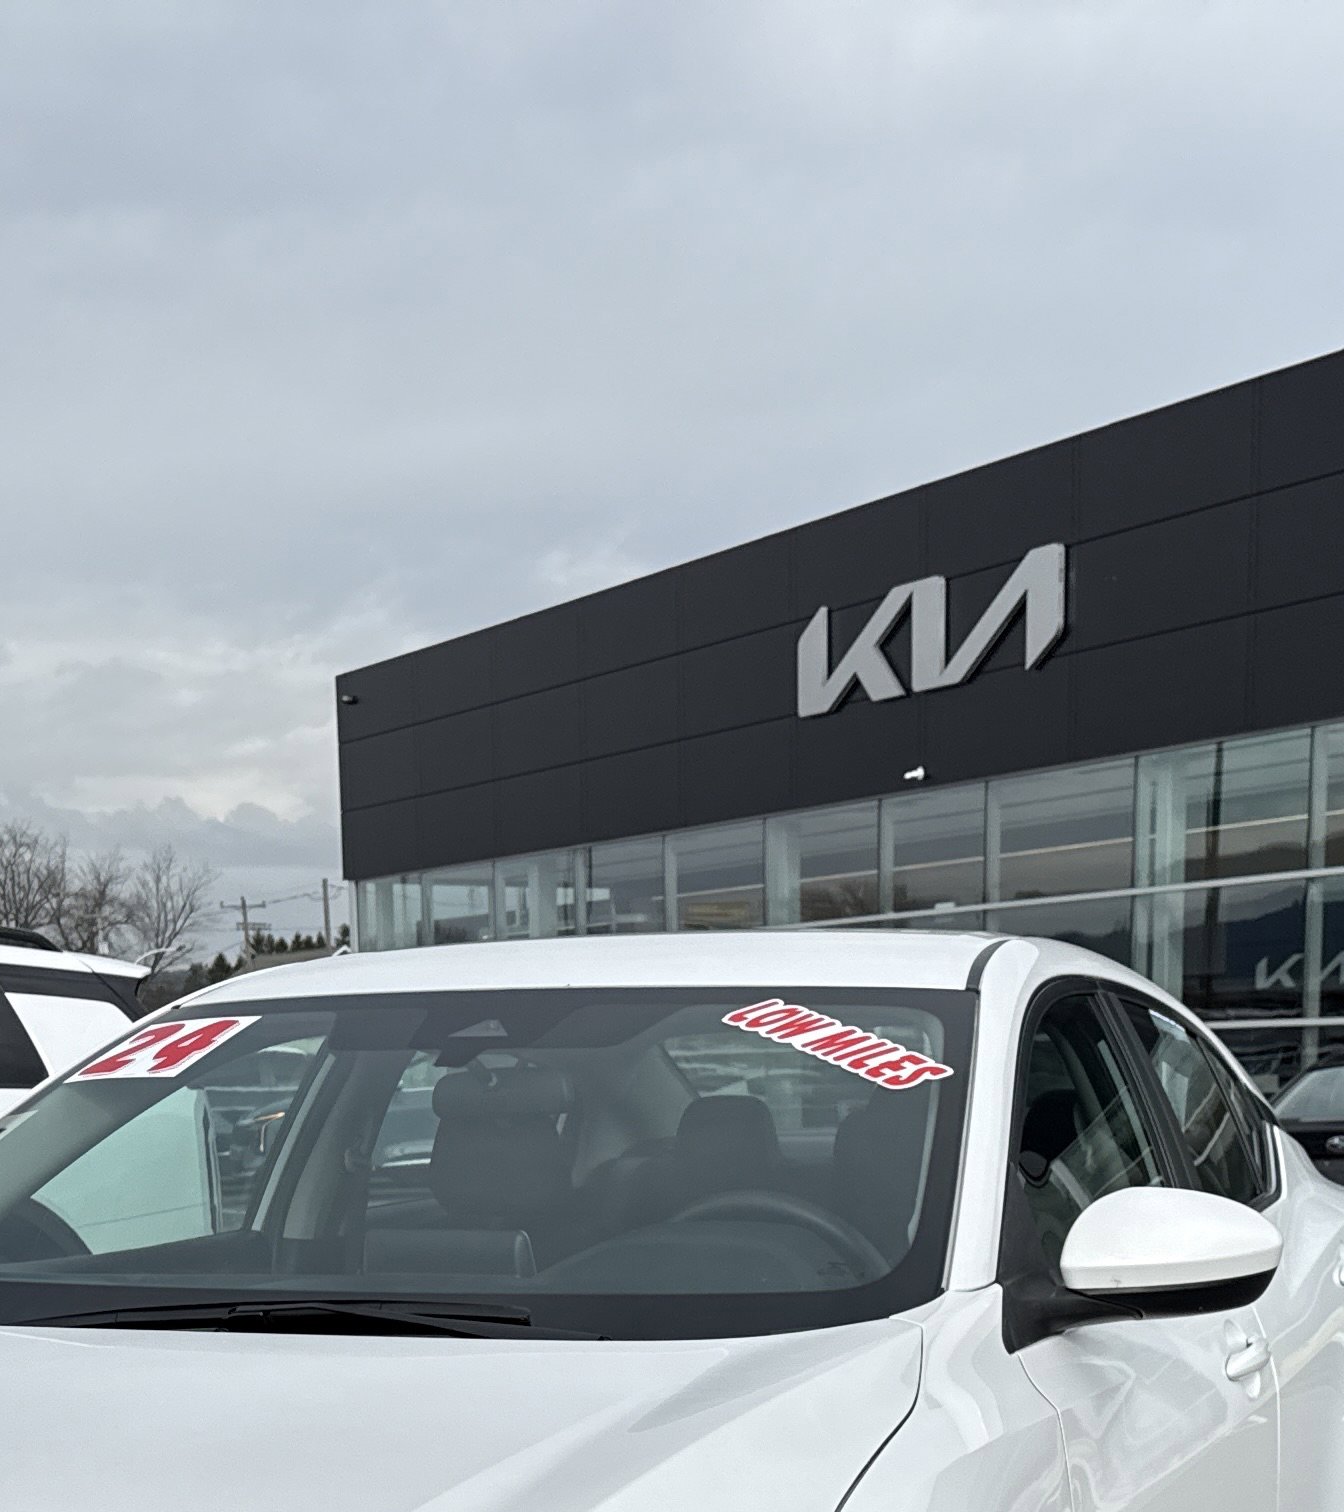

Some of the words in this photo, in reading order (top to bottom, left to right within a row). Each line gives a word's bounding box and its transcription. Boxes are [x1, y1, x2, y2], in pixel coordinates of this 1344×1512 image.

[797, 542, 1066, 718] KIA
[78, 1020, 240, 1076] 24
[726, 1001, 836, 1041] LOW
[801, 1029, 948, 1086] MILES
